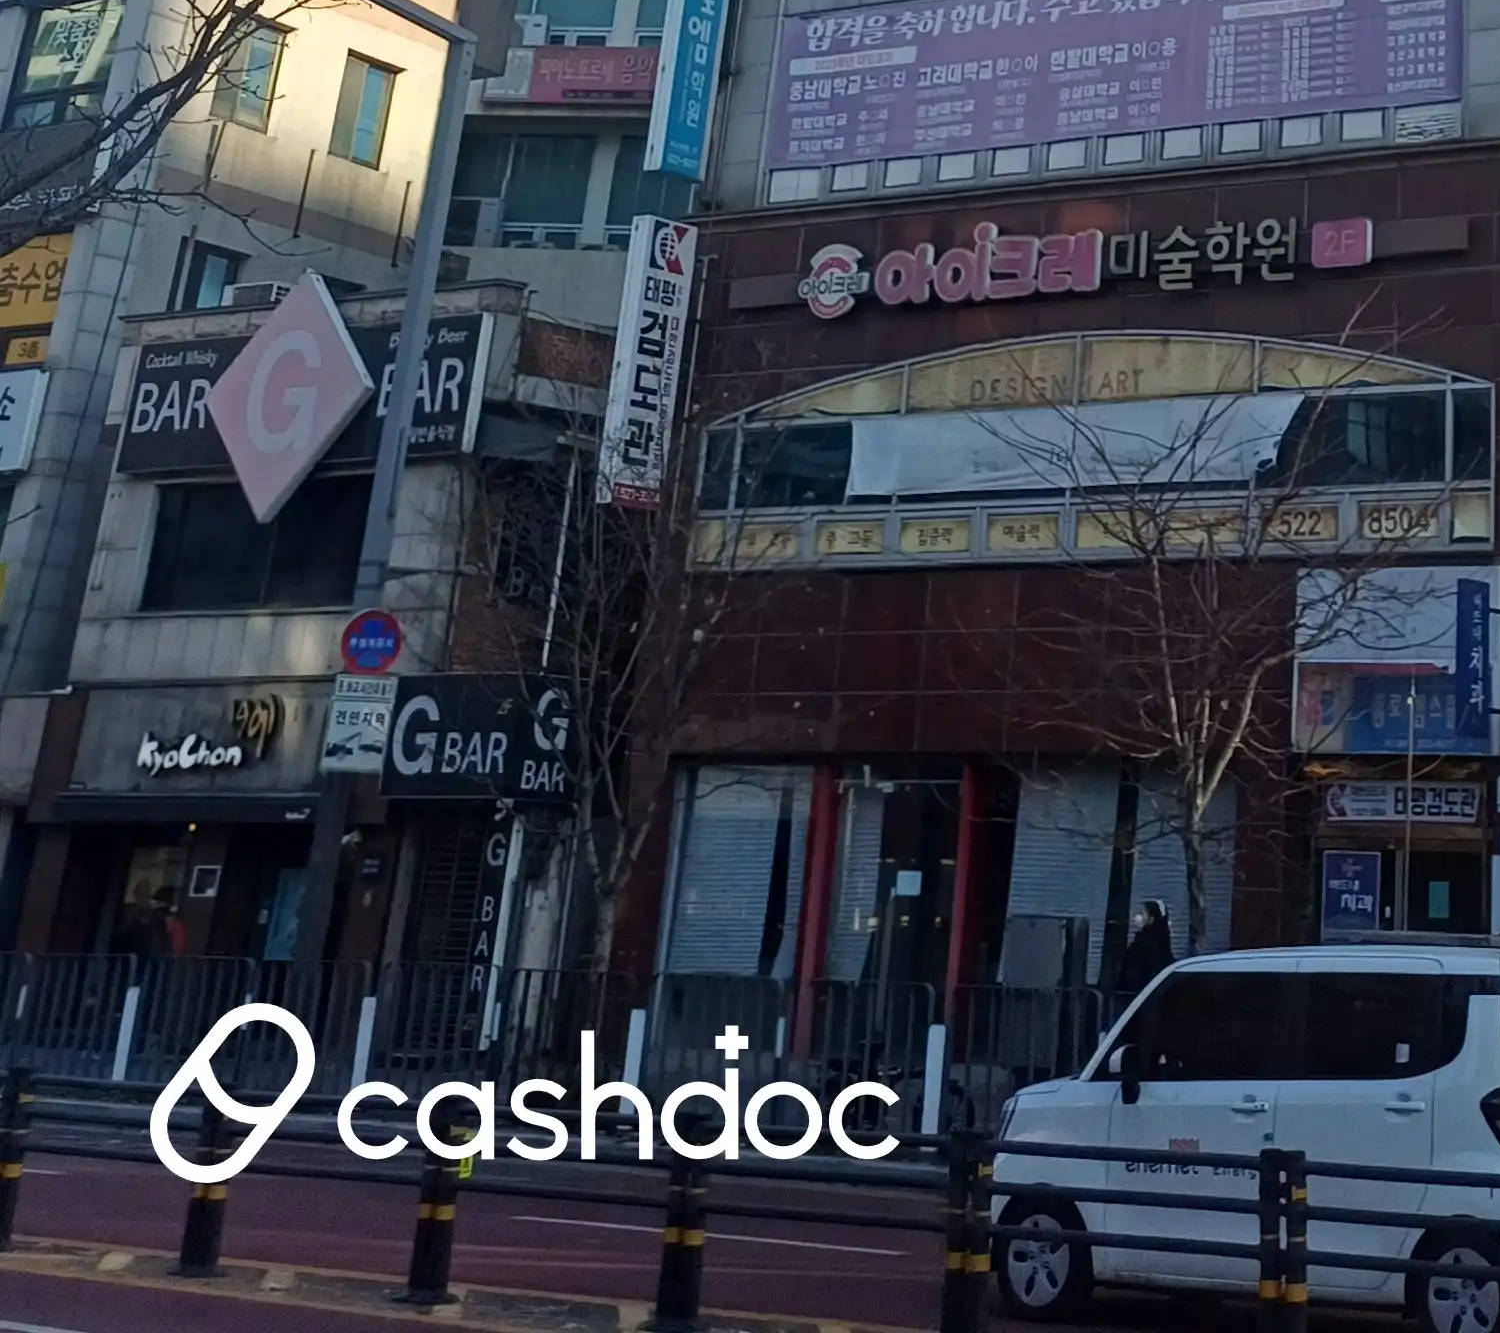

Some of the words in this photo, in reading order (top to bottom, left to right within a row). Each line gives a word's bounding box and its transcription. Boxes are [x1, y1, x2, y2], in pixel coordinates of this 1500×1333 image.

[805, 13, 890, 52] 합격을
[1108, 215, 1297, 292] 미술학원
[1322, 228, 1357, 257] 2F
[131, 379, 211, 434] BAR
[246, 328, 322, 455] G
[1097, 369, 1145, 397] ART
[1278, 510, 1322, 537] 522
[392, 695, 441, 775] G
[441, 730, 509, 775] BAR
[519, 759, 566, 792] BAR
